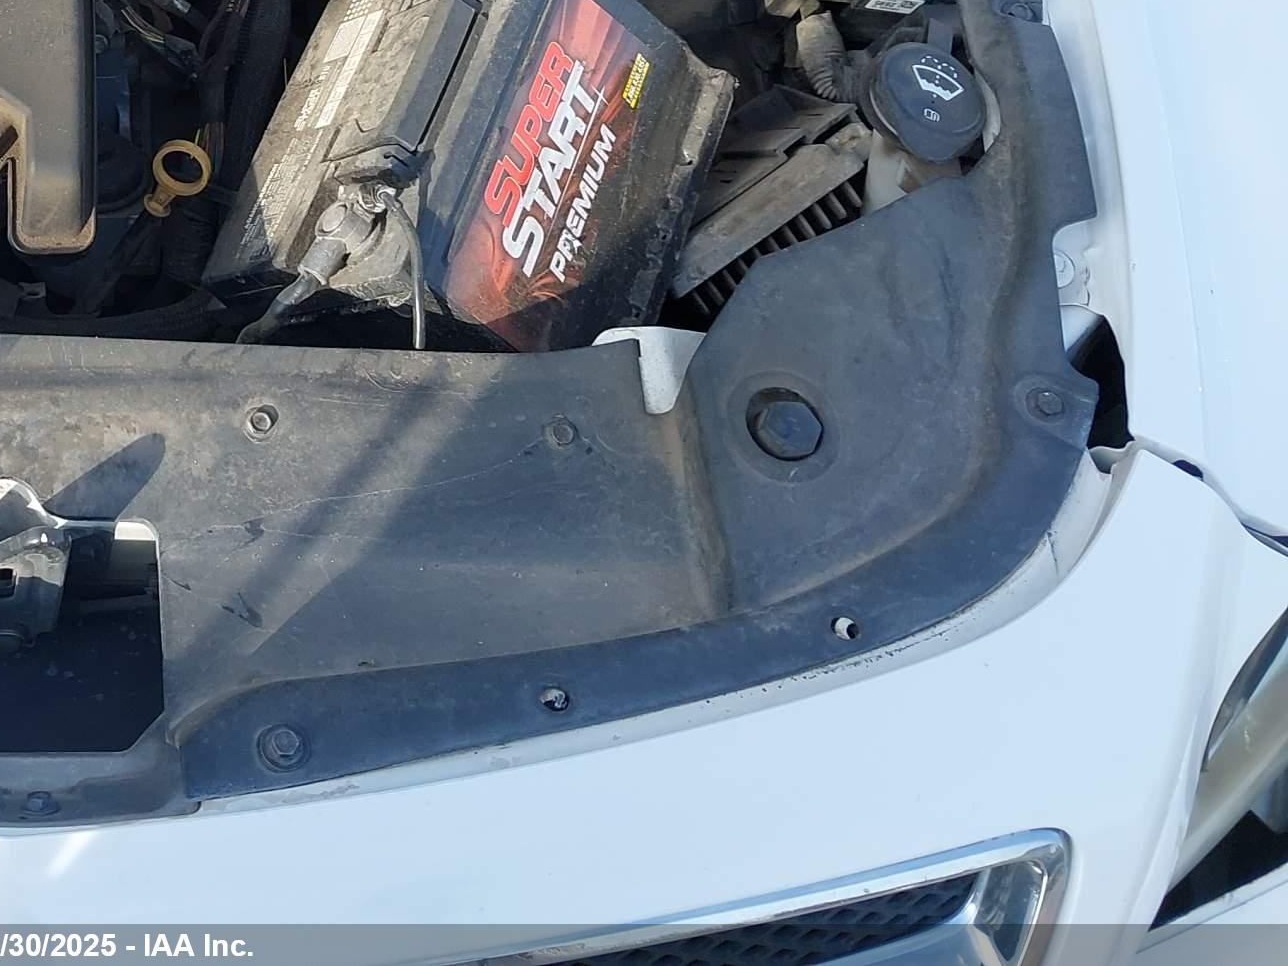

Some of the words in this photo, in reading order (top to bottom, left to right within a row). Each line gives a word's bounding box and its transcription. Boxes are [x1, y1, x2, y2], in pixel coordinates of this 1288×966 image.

[484, 41, 573, 228] SUPER
[502, 59, 595, 277] START
[549, 123, 617, 283] PREMIUM
